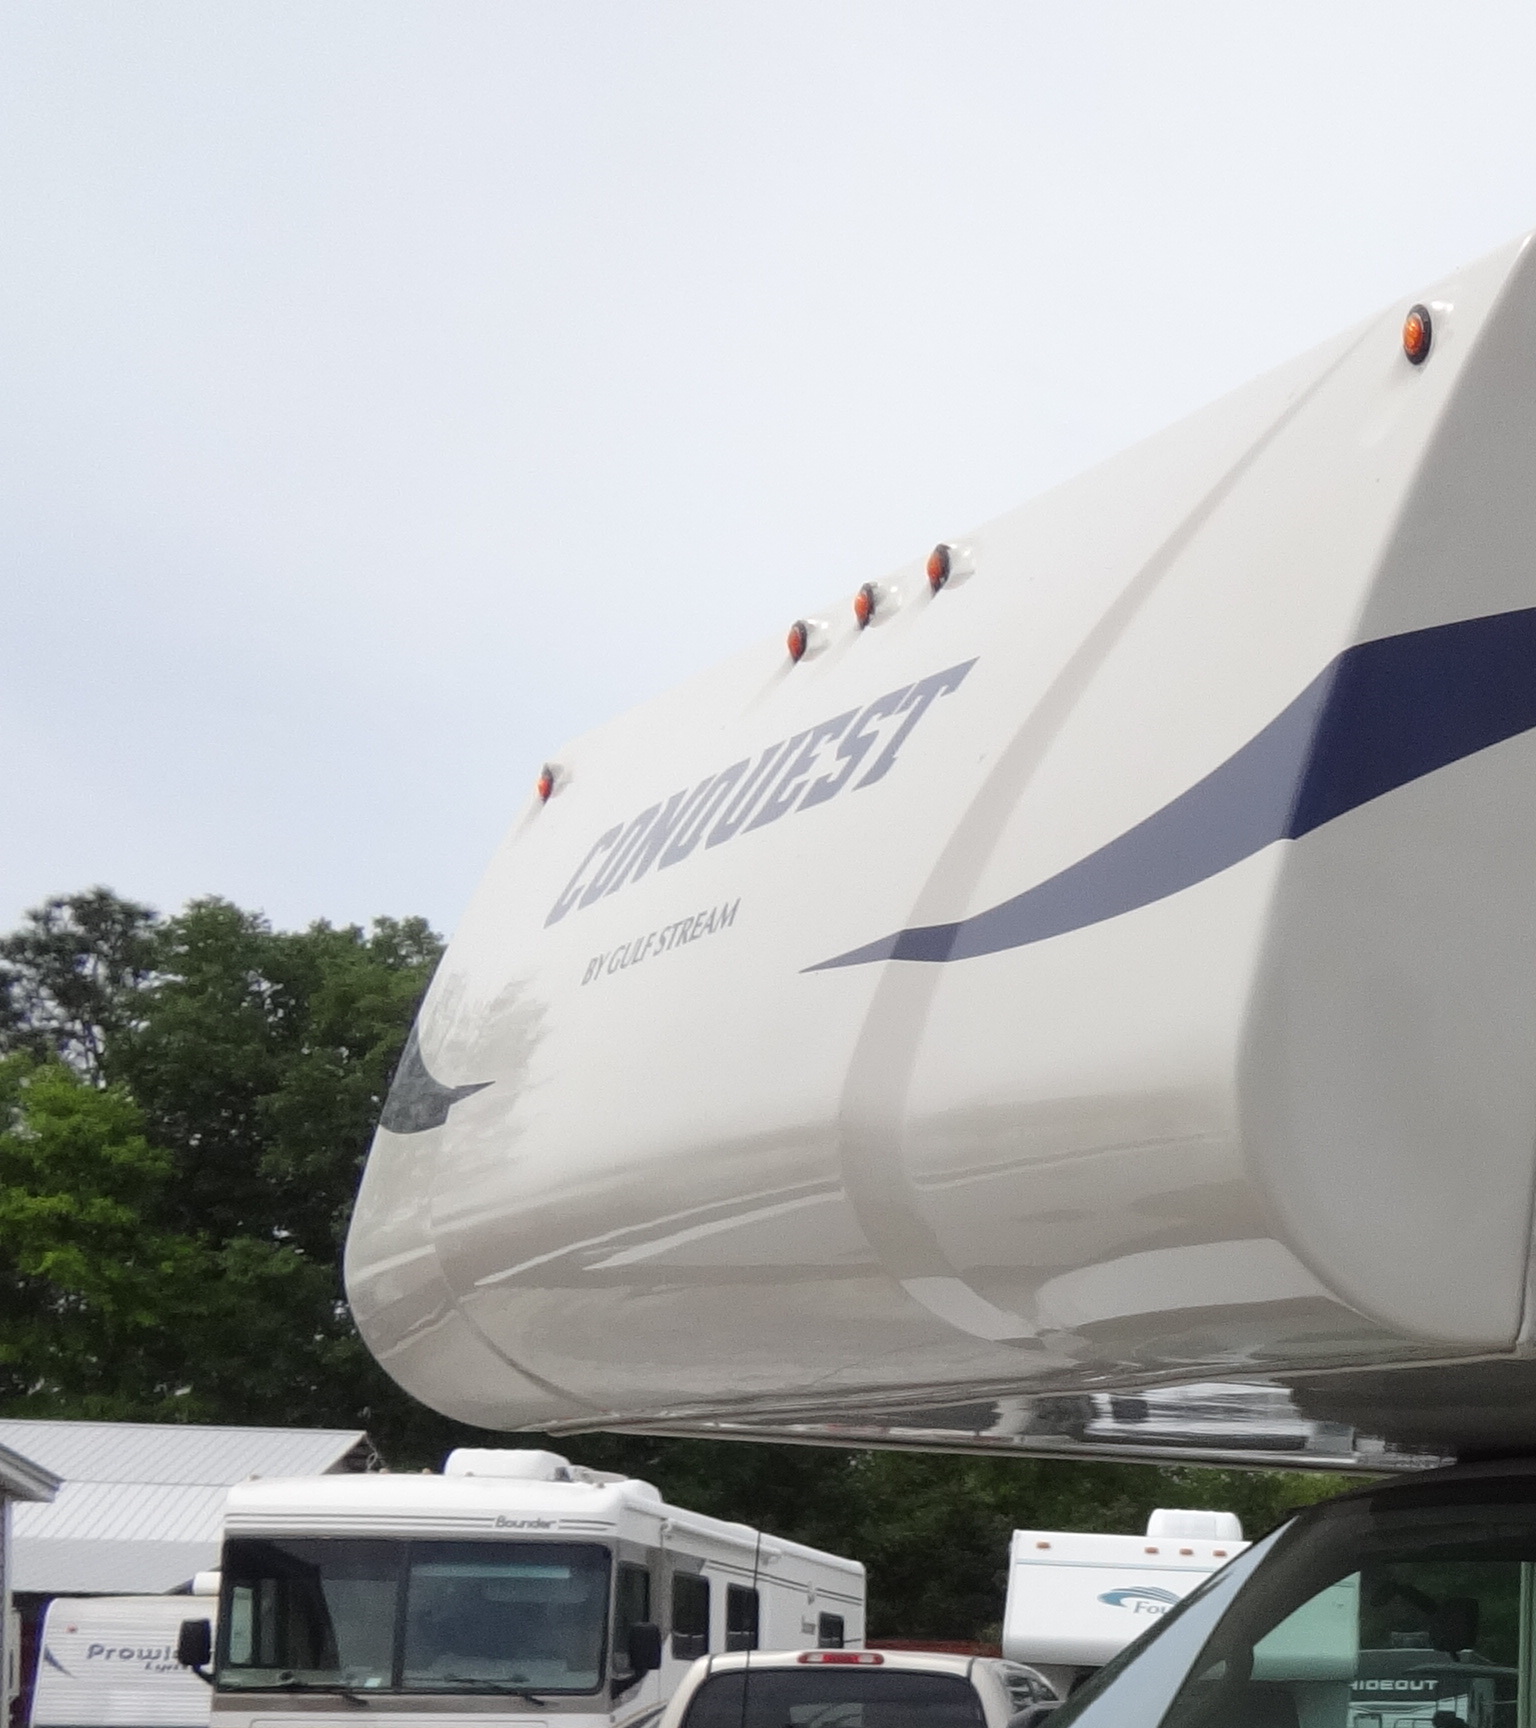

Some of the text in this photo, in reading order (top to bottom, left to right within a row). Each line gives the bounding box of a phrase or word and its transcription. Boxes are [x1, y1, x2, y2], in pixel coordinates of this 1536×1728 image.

[544, 656, 979, 928] CONQUEST
[581, 897, 741, 986] BY GULF STREAM
[1133, 1600, 1169, 1614] Fou
[86, 1643, 179, 1661] Prowl
